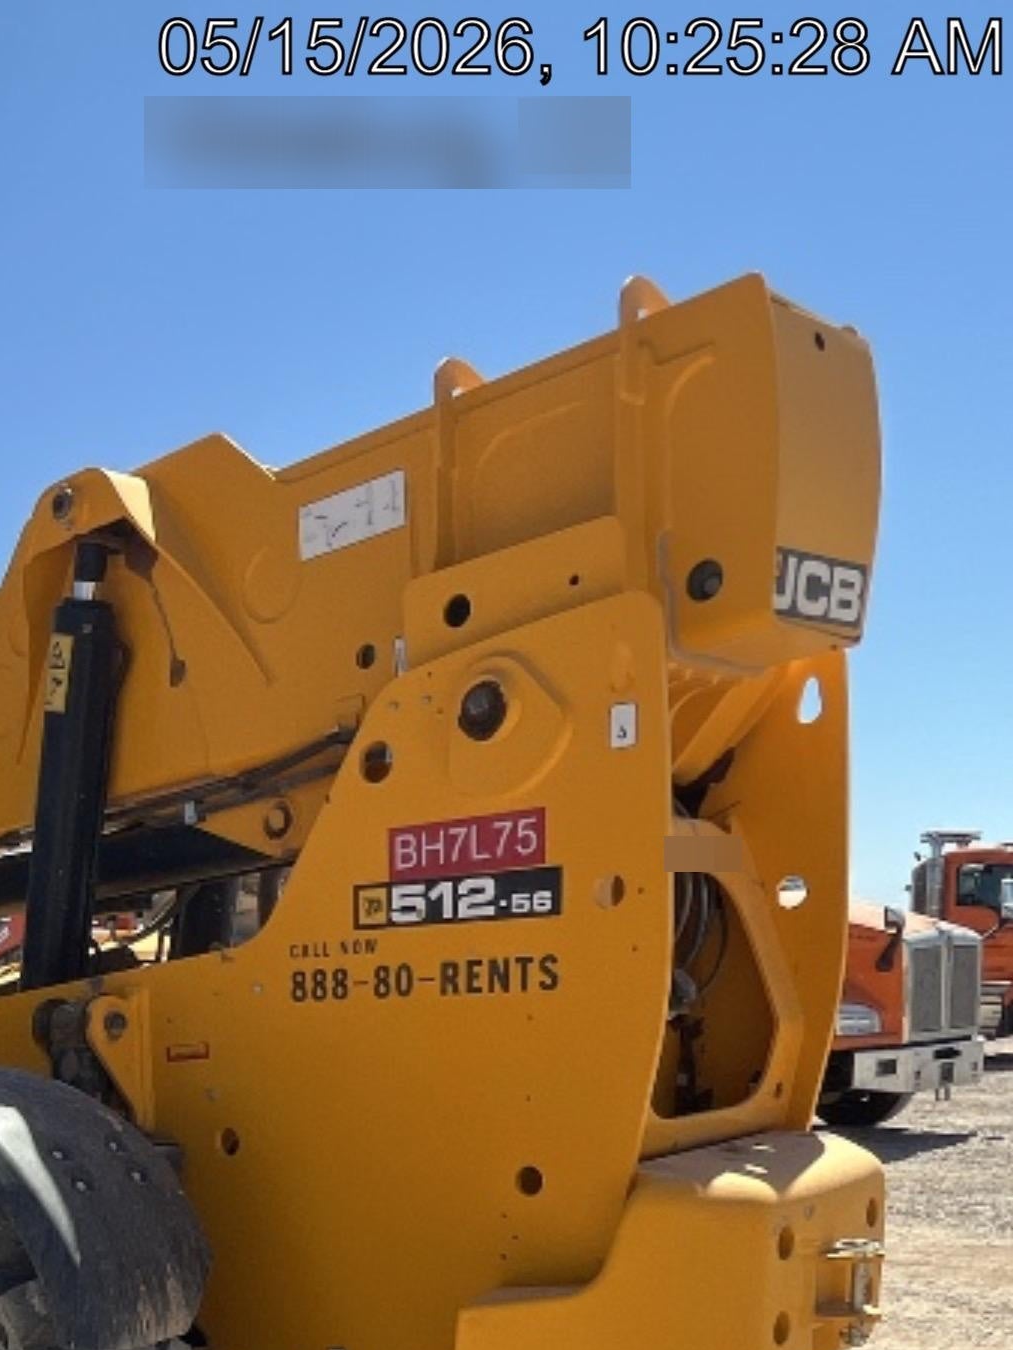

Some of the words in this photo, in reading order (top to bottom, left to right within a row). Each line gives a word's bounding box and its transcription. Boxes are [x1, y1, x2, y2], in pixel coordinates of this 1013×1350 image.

[773, 551, 865, 623] JCB
[393, 815, 538, 871] BH7L75
[289, 941, 330, 958] CALL
[339, 938, 379, 955] NOW
[290, 953, 560, 1003] 888-80-RENTS
